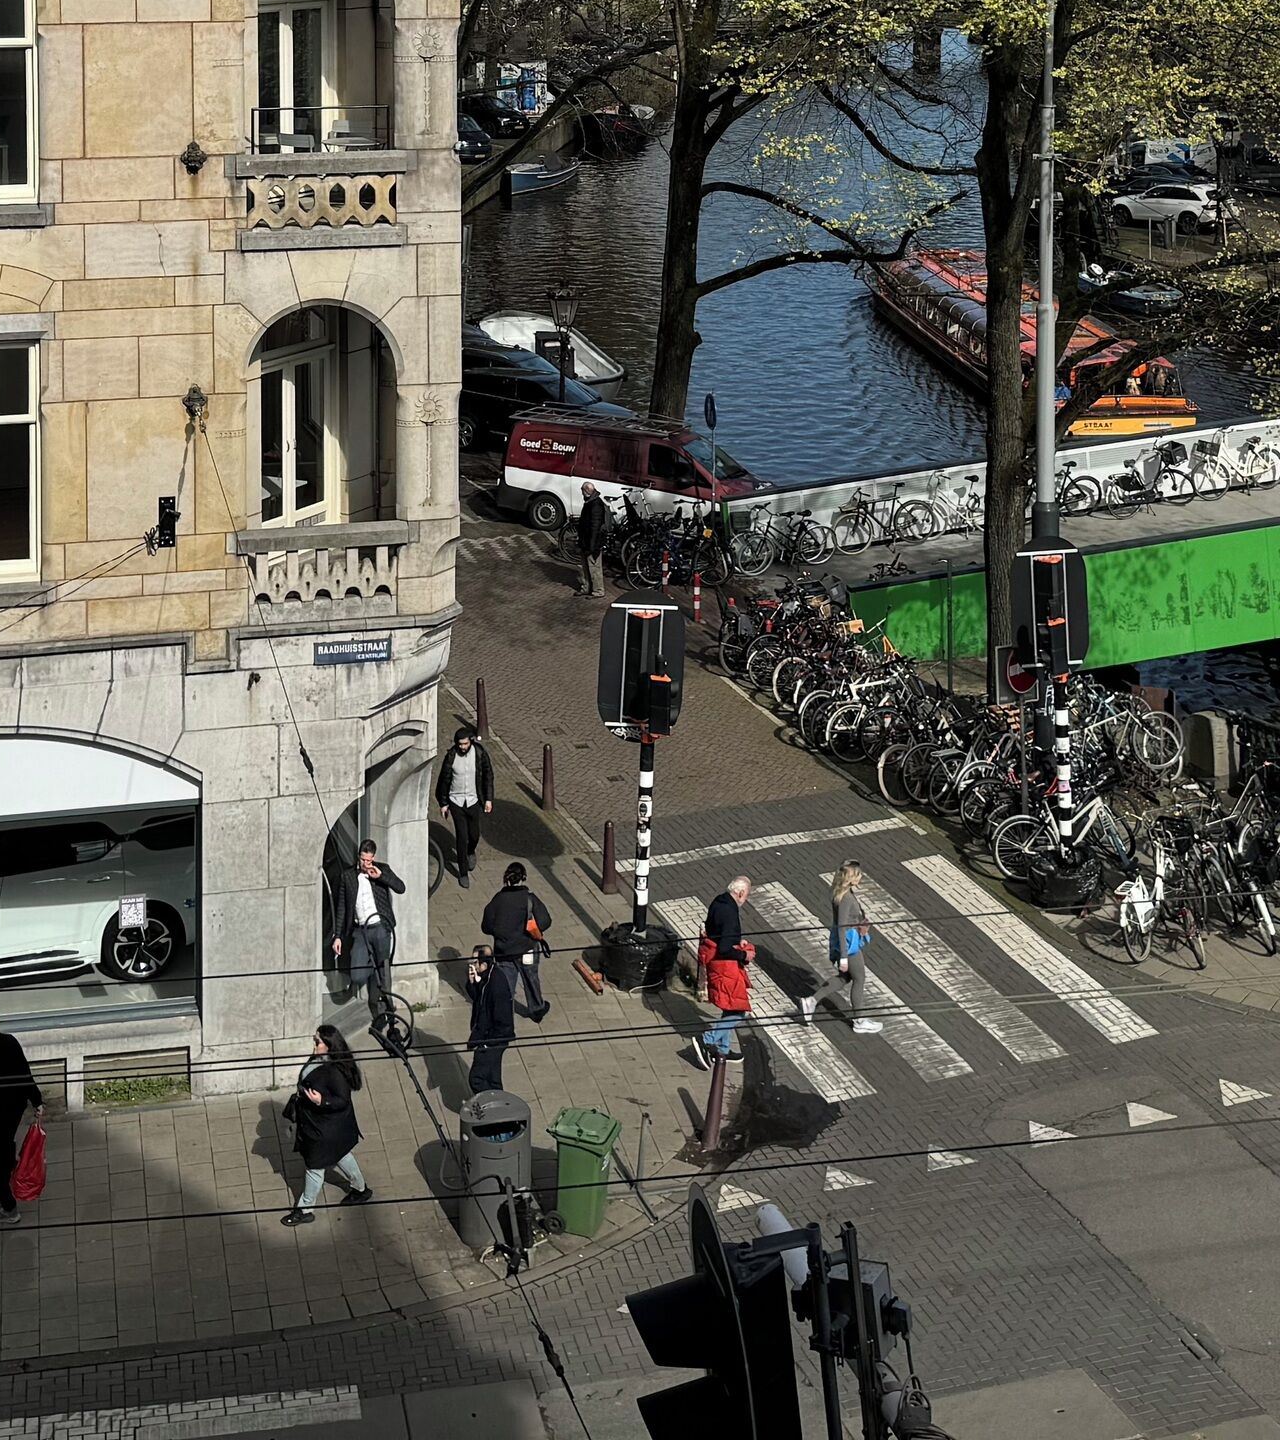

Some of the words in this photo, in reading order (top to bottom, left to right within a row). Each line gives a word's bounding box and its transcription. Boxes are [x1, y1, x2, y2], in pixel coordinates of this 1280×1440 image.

[520, 438, 541, 449] Goed
[552, 442, 576, 453] Bouw
[317, 641, 388, 655] RAADHUISSTRAAT
